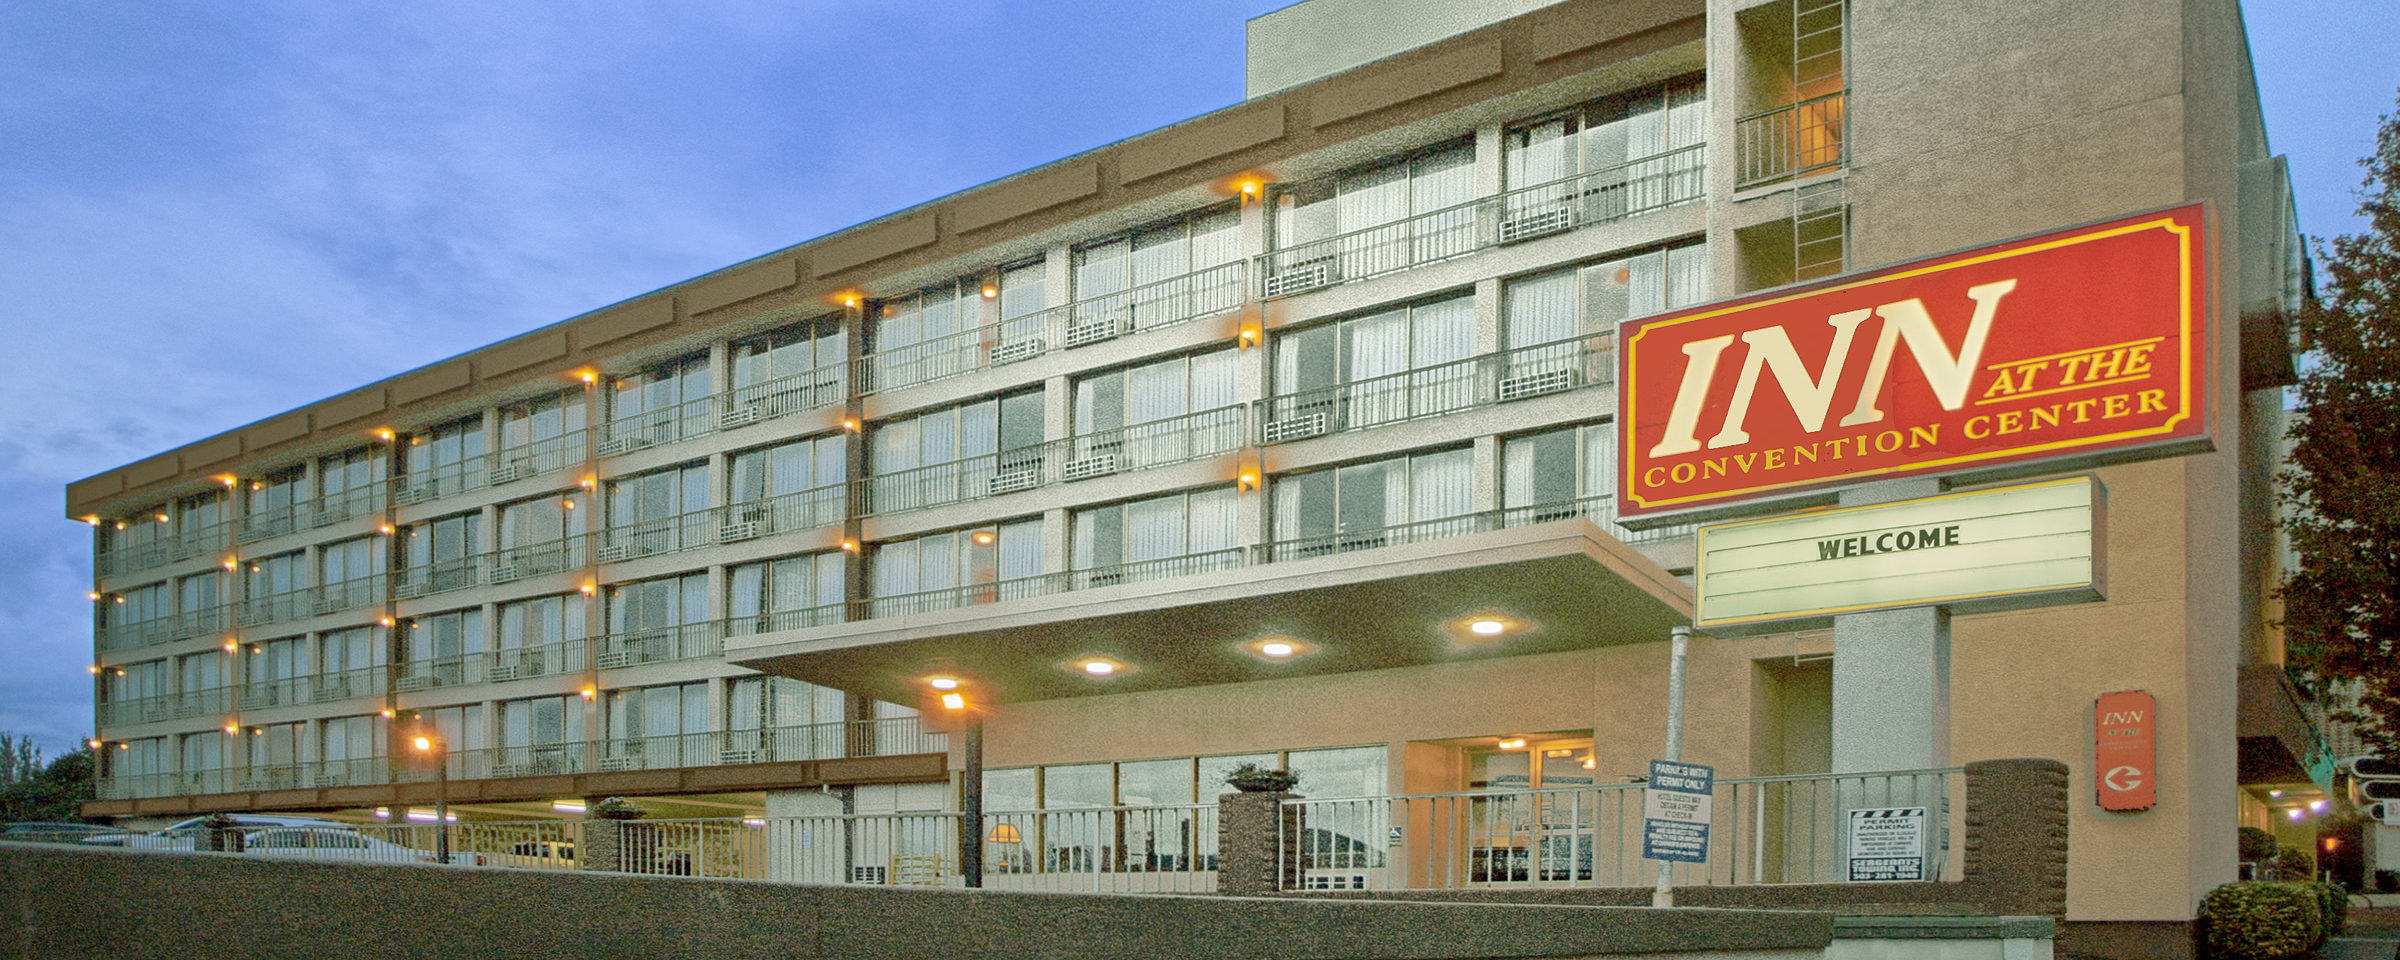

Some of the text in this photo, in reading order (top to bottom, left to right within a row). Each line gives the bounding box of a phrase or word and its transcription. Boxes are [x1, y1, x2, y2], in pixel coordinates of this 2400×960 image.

[1648, 277, 2018, 459] INN
[1983, 343, 2157, 399] AT THE
[1643, 388, 2170, 489] CONVENTION CENTER
[1817, 524, 1961, 562] WELCOME
[2103, 710, 2144, 725] INN
[1657, 776, 1705, 789] PERMIT ONLY
[1690, 767, 1708, 778] WITH
